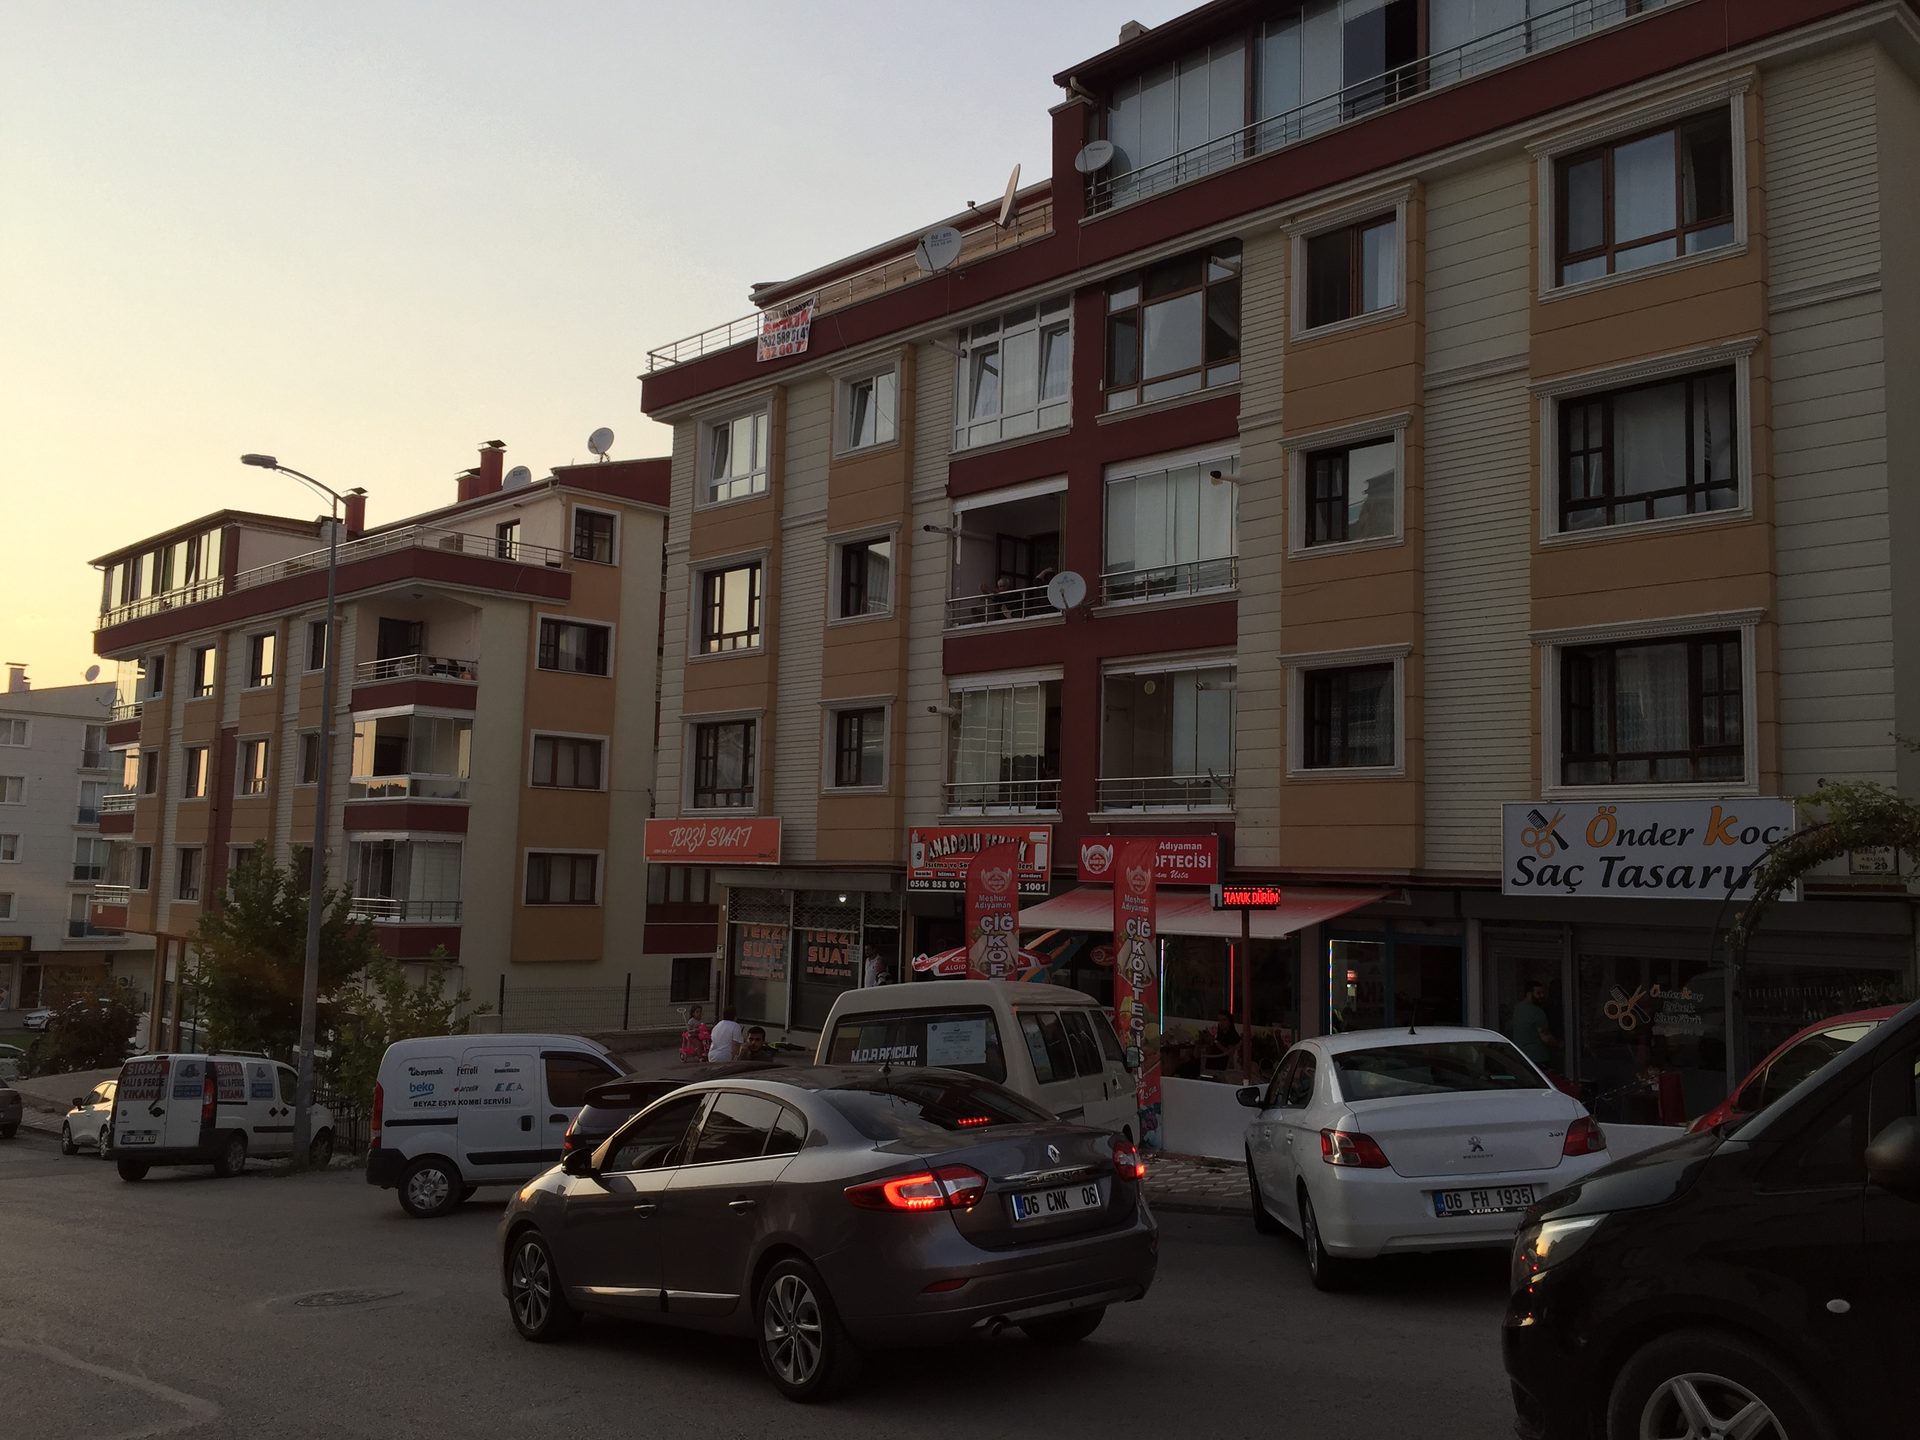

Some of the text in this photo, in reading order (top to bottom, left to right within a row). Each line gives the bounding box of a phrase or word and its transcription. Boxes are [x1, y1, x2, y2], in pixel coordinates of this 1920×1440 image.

[1585, 805, 1694, 848] Önder
[669, 823, 752, 853] TERZİ SUAT
[928, 833, 981, 860] ANADOLU
[1159, 841, 1202, 852] Adıyaman
[1511, 855, 1584, 893] Saç
[910, 880, 929, 888] 0506
[1025, 882, 1046, 891] 1001
[980, 912, 1014, 935] ÇİĞ
[1126, 916, 1152, 938] ÇİĞ
[743, 941, 783, 960] SUAT
[808, 946, 848, 965] SUAT
[126, 1061, 162, 1075] SIRMA
[457, 1066, 478, 1076] Ferroli
[409, 1082, 435, 1092] beko
[438, 1099, 456, 1107] EŞYA
[458, 1098, 482, 1106] KOMBİ
[483, 1097, 511, 1105] SERVİSİ
[1023, 1187, 1097, 1215] 06 CNK 06
[1445, 1188, 1530, 1209] 06 FH 1935
